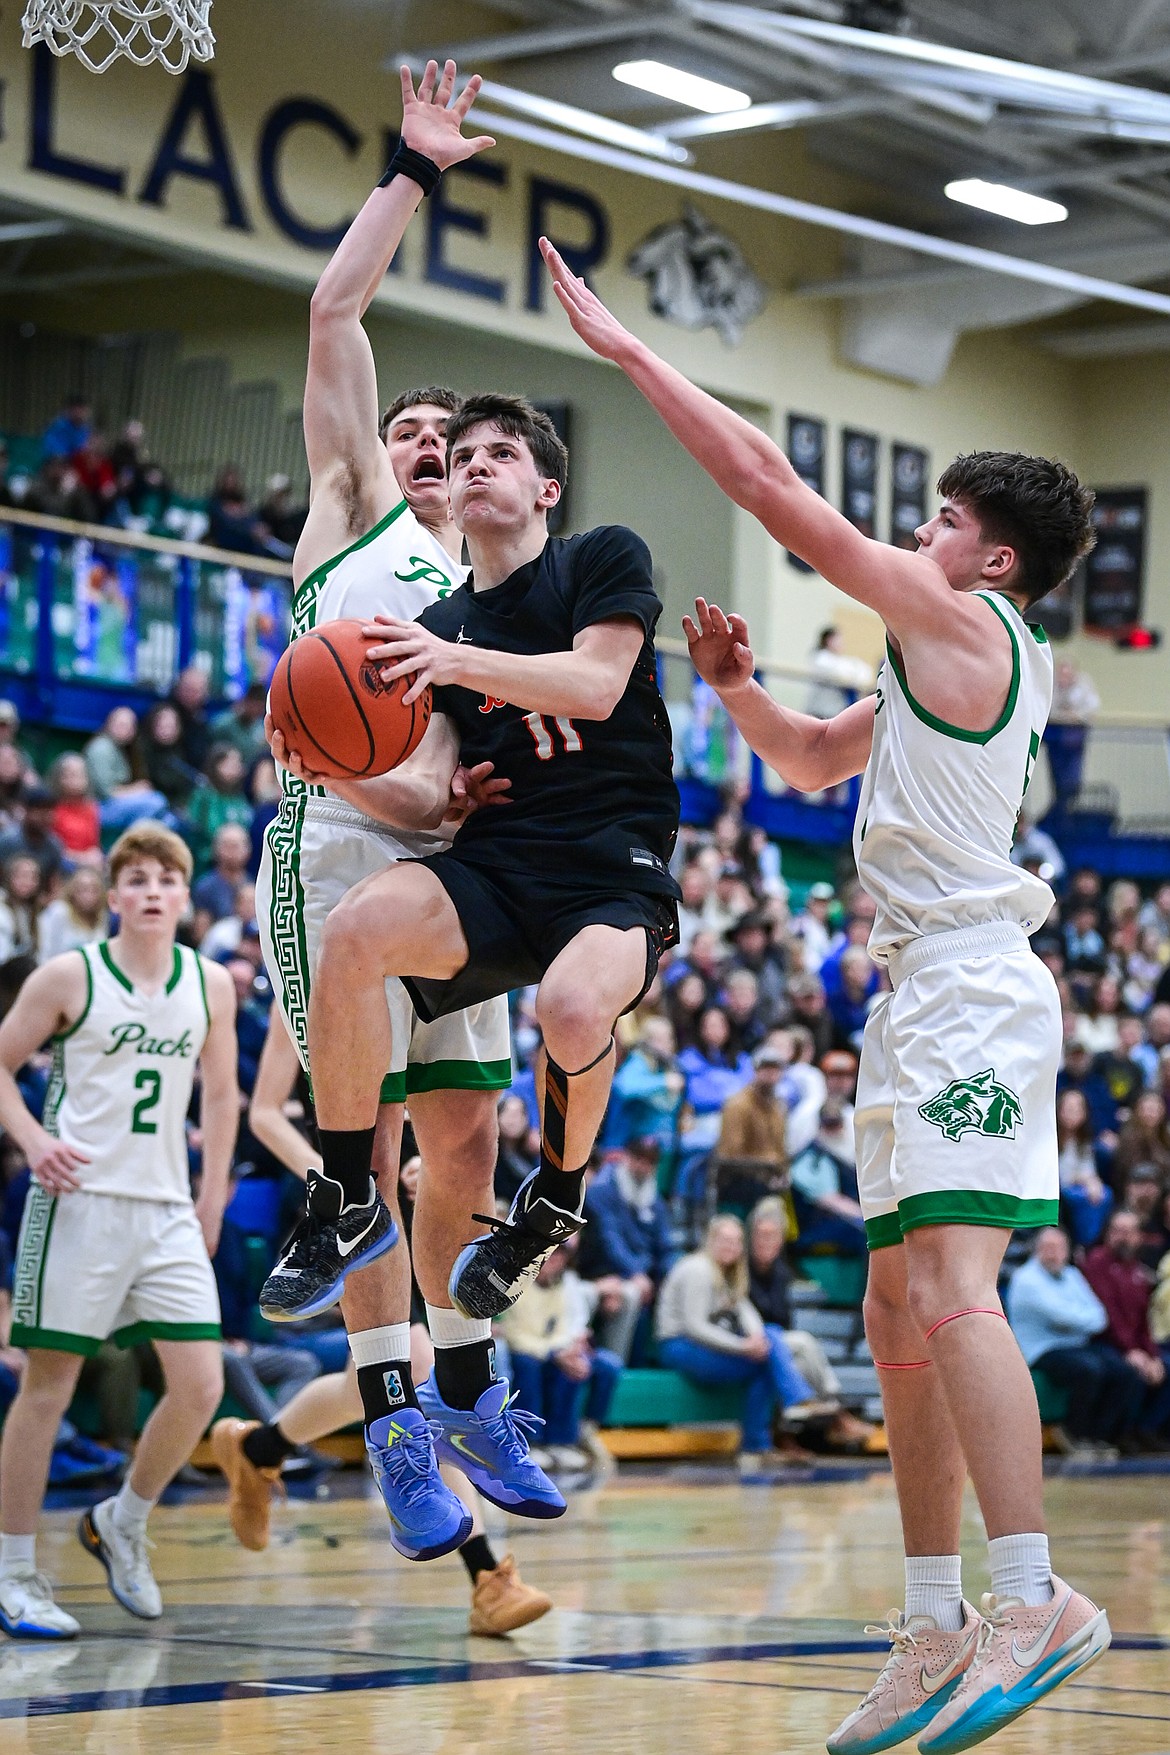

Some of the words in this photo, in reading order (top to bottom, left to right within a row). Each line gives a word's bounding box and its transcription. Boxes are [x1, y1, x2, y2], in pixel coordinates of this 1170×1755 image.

[0, 36, 609, 314] LACER
[522, 711, 584, 761] 11
[104, 1021, 192, 1057] Pack
[131, 1068, 162, 1134] 2
